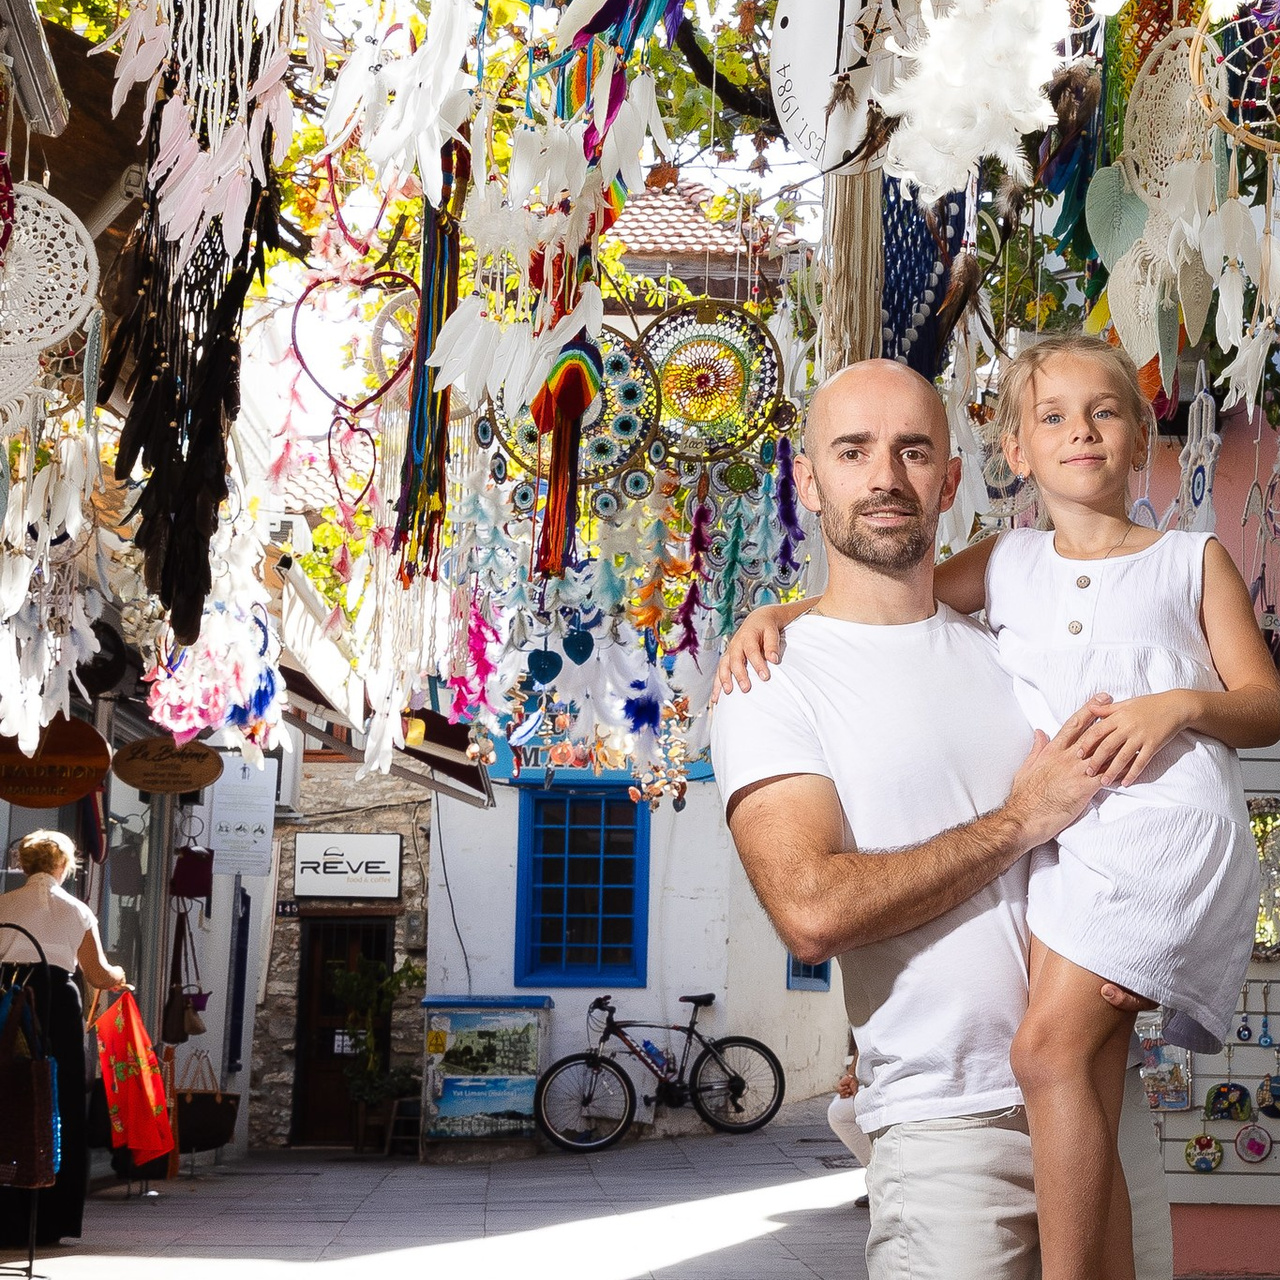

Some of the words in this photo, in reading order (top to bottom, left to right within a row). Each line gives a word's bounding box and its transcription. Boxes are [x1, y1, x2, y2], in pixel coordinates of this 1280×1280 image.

[776, 62, 800, 123] 1984
[794, 117, 826, 162] EST.
[126, 744, 150, 762] La
[346, 875, 363, 884] food
[371, 875, 391, 884] coffee
[278, 903, 298, 914] 145
